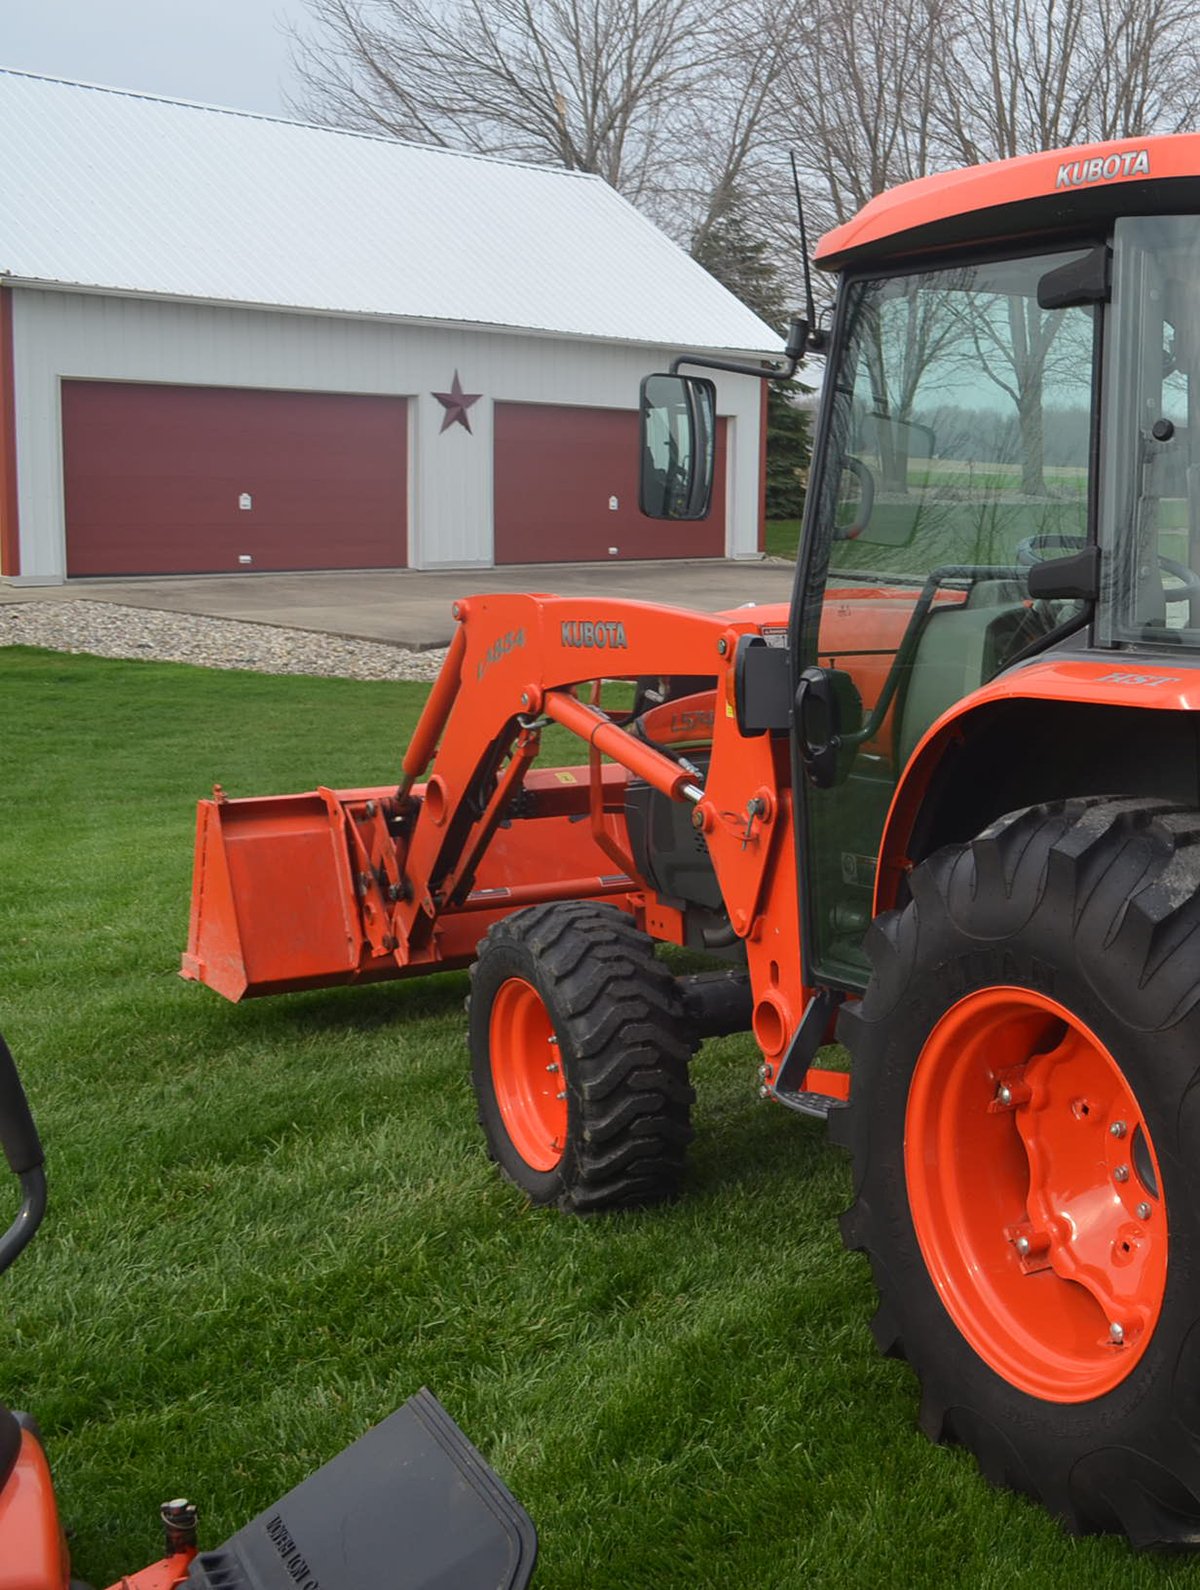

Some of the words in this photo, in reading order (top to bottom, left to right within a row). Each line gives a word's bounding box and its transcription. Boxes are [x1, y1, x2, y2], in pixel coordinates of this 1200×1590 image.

[1055, 148, 1151, 189] KUBOTA
[561, 620, 629, 649] KUBOTA
[1094, 672, 1184, 687] HST
